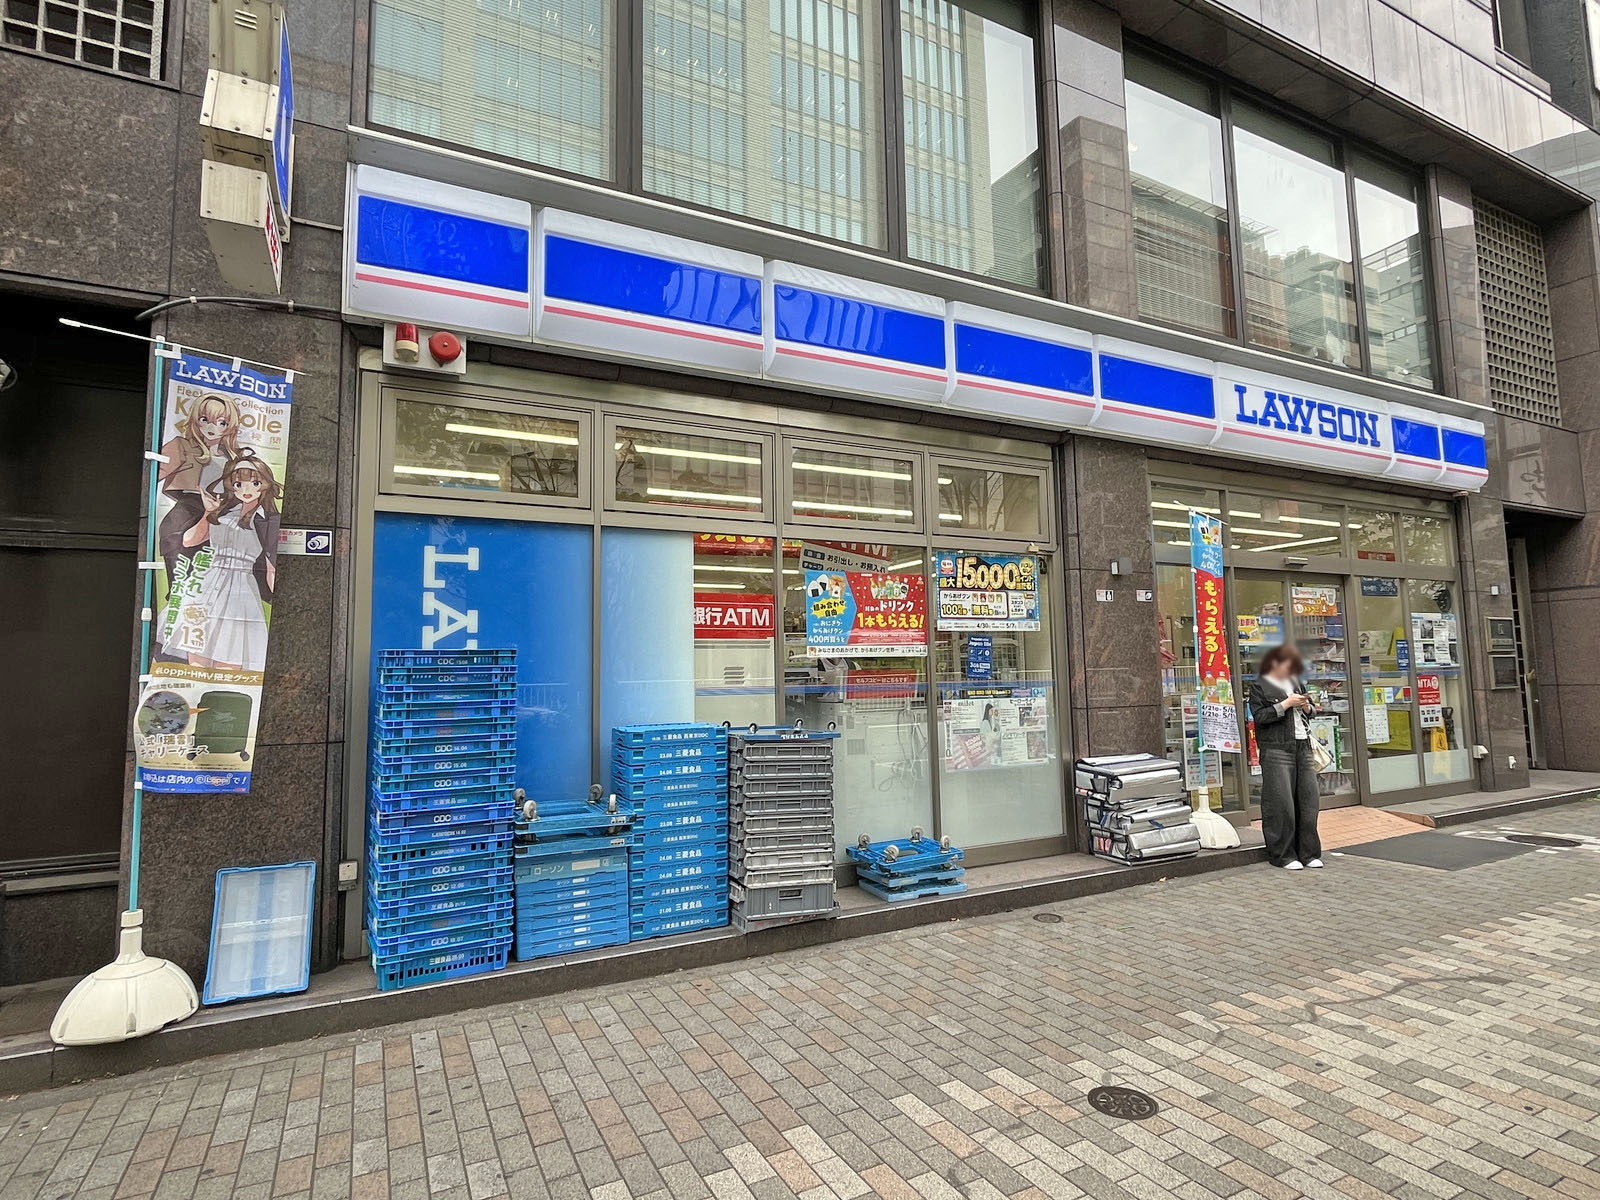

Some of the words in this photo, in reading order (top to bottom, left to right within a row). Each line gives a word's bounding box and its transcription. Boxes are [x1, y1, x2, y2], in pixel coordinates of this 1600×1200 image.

[176, 360, 287, 399] LAWSON
[1234, 384, 1381, 447] LAWSON
[940, 577, 955, 588] 最大
[422, 545, 480, 650] LA
[813, 600, 845, 612] 組み合わせ
[824, 609, 838, 618] 自由
[857, 612, 925, 629] 1本もらえる!
[1203, 579, 1220, 667] もらえる!
[808, 635, 846, 644] 400円買うと
[139, 745, 209, 759] キャリーケース
[434, 744, 452, 752] CDC
[675, 748, 702, 757] 三菱食品
[675, 765, 702, 774] 三菱食品
[434, 779, 452, 787] CDC
[433, 814, 451, 823] CDC
[675, 816, 702, 825] 三菱食品
[675, 849, 702, 859] 三菱食品
[432, 866, 450, 874] CDC
[534, 865, 565, 875] ローソン
[675, 866, 702, 876] 三菱食品
[431, 883, 449, 892] CDC
[675, 900, 702, 911] 三菱食品
